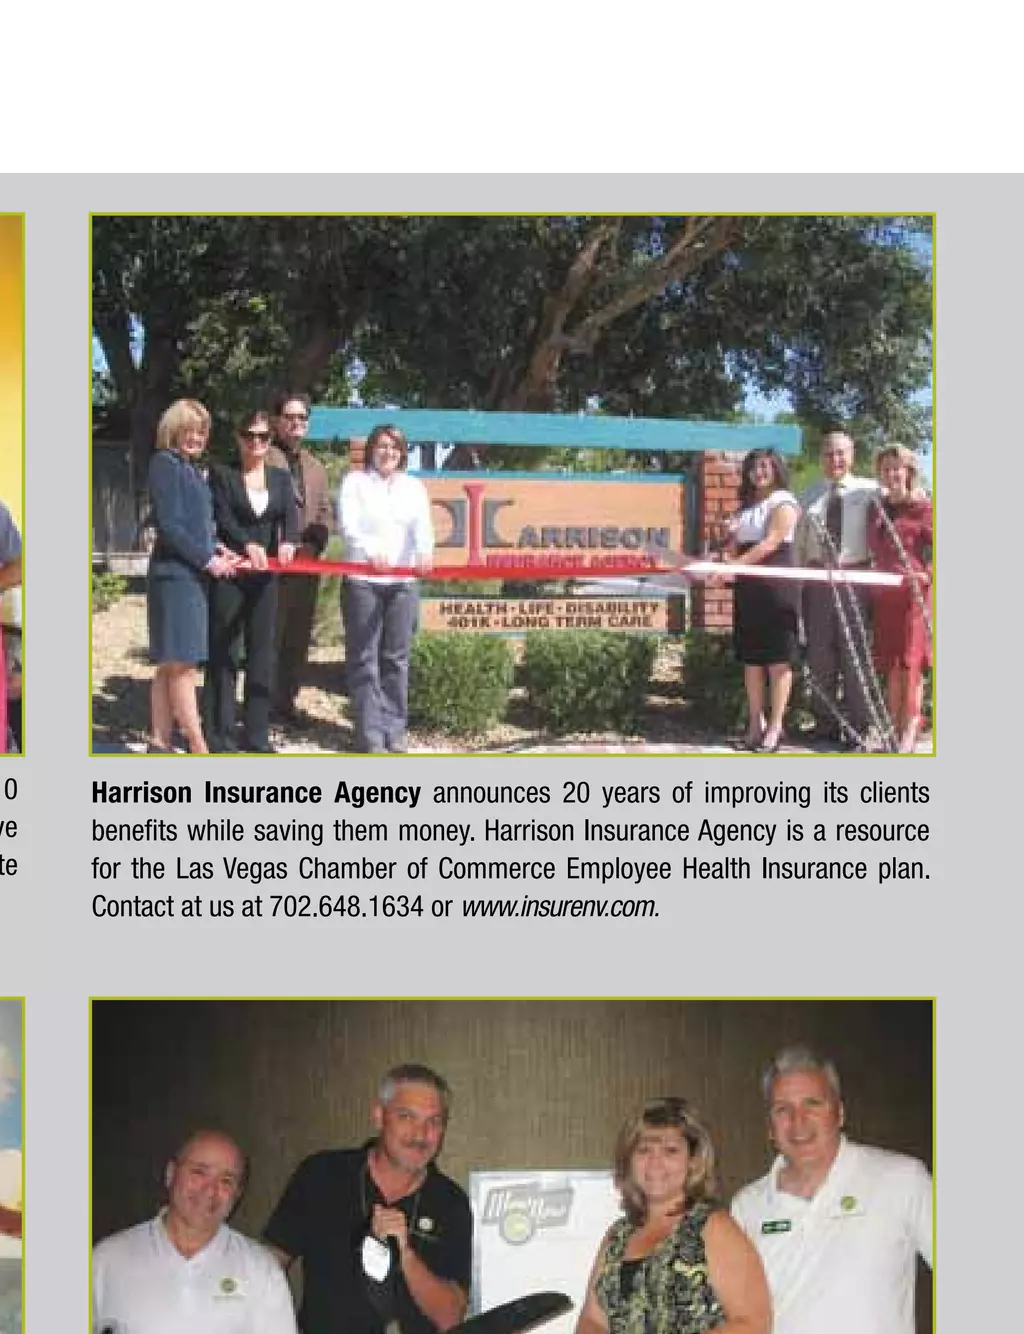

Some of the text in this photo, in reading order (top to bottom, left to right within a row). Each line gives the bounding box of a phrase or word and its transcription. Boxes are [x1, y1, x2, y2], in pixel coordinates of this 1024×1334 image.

[439, 601, 508, 615] HEALTH
[518, 601, 554, 615] LIFE
[92, 780, 930, 809] Harrison Insurance Agency announces 20 years of improving its clients
[92, 894, 660, 918] Contact at us at 702.648.1634 or www.insurenv.com.
